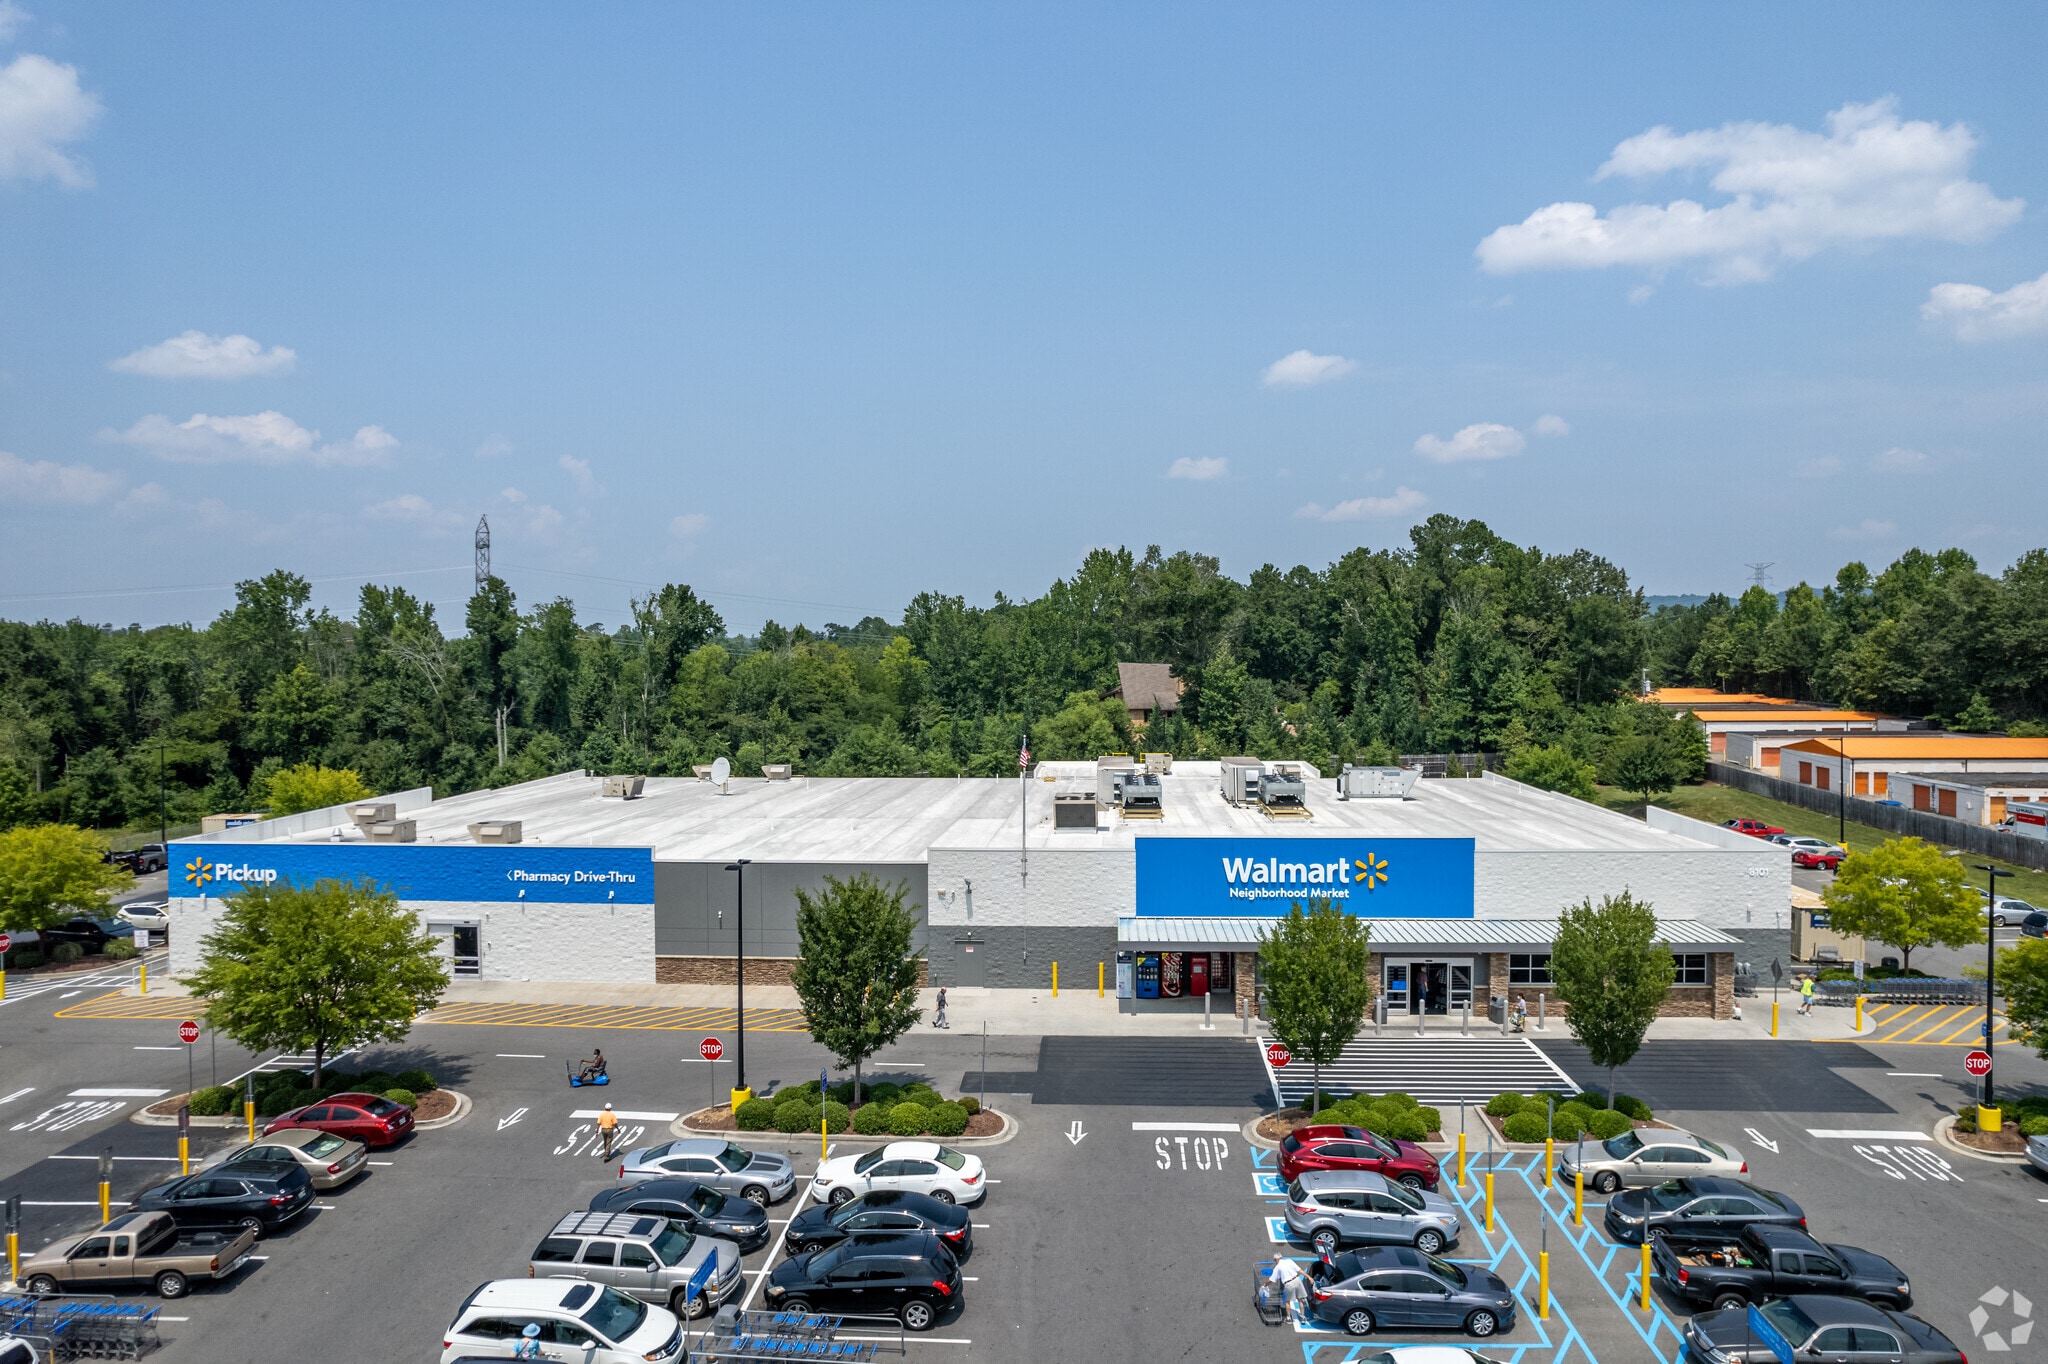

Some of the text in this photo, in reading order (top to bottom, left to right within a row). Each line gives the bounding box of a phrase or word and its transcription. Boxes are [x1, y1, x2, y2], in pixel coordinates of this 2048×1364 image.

[215, 863, 277, 887] Pickup
[514, 869, 636, 885] Pharmacy Drive-Thru
[1222, 857, 1350, 883] Walmart
[1229, 887, 1350, 900] Neighborhood Market
[180, 1027, 198, 1036] STOP
[701, 1044, 721, 1053] STOP
[1268, 1050, 1290, 1059] STOP
[1966, 1058, 1990, 1068] STOP
[9, 1101, 127, 1132] STOP
[1155, 1136, 1229, 1171] STOP
[1852, 1145, 1965, 1182] STOP
